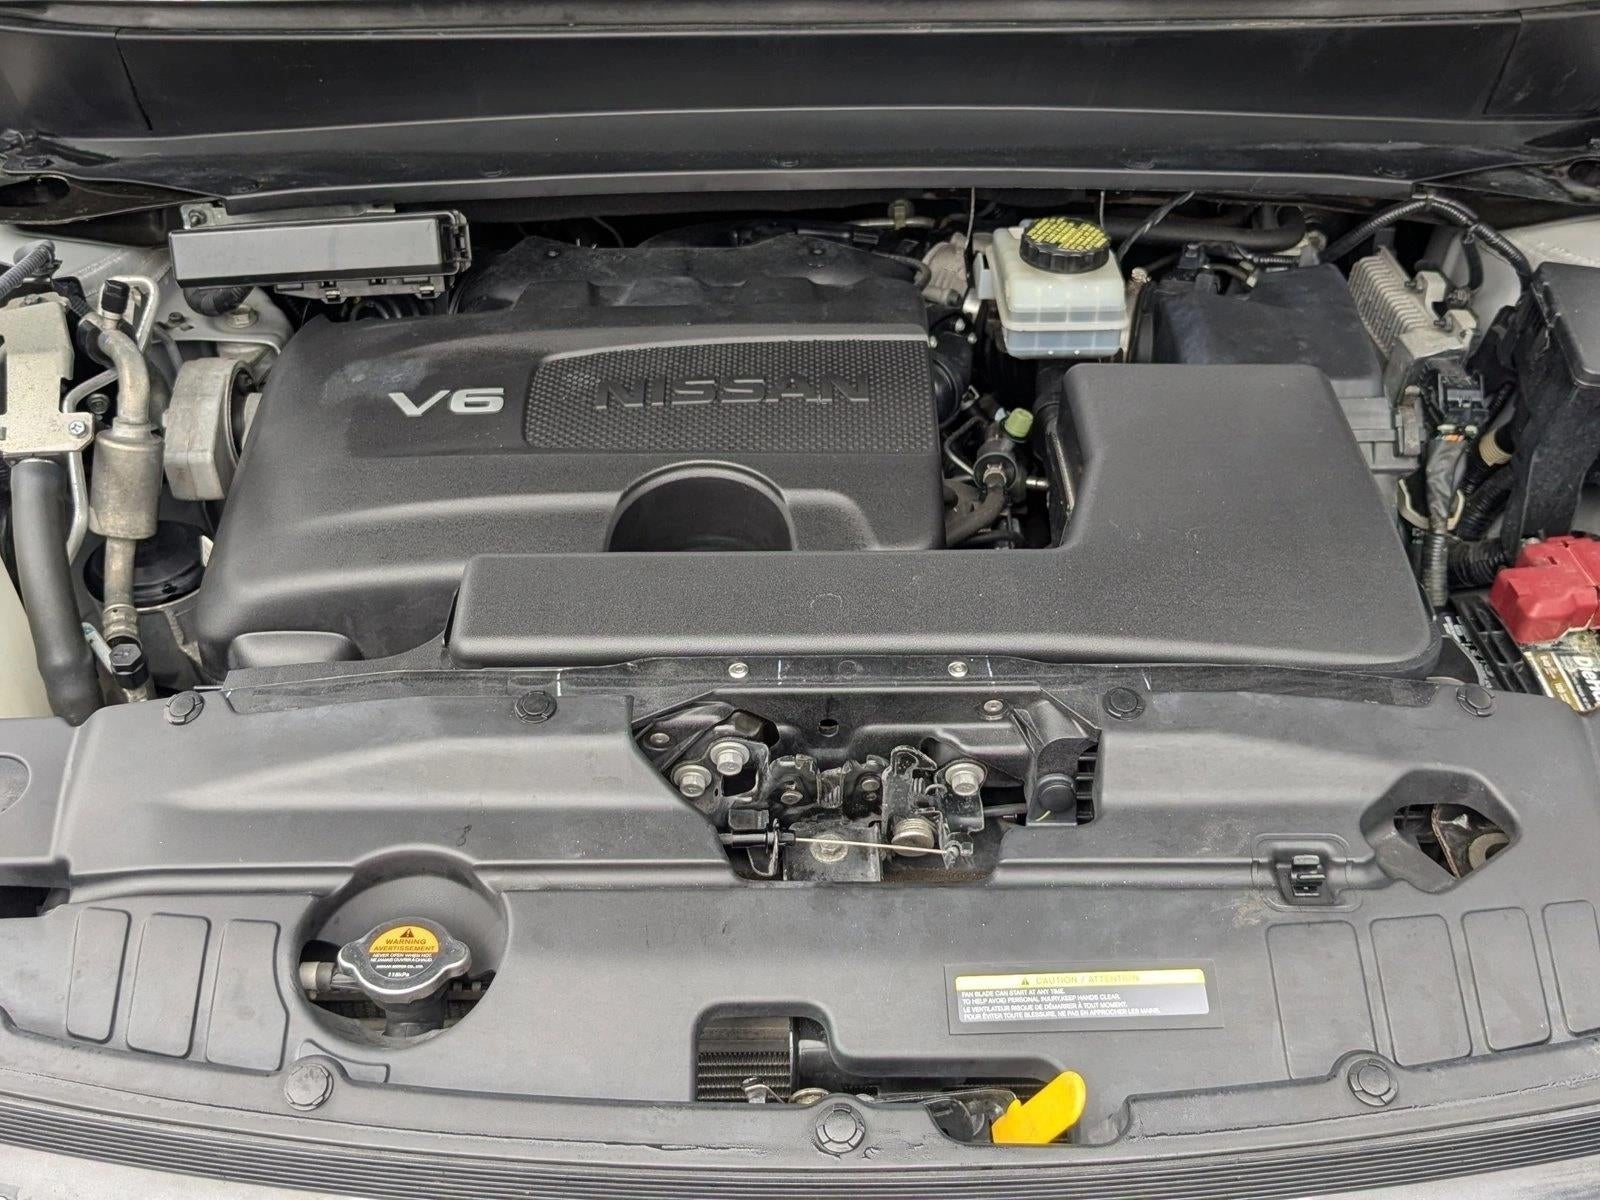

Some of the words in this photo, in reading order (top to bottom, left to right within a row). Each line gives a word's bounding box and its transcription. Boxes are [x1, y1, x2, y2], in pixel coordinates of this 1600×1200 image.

[388, 387, 504, 417] V6
[595, 373, 870, 409] NISSAN
[1036, 975, 1077, 985] CAUTION
[1088, 974, 1140, 984] ATTENTION
